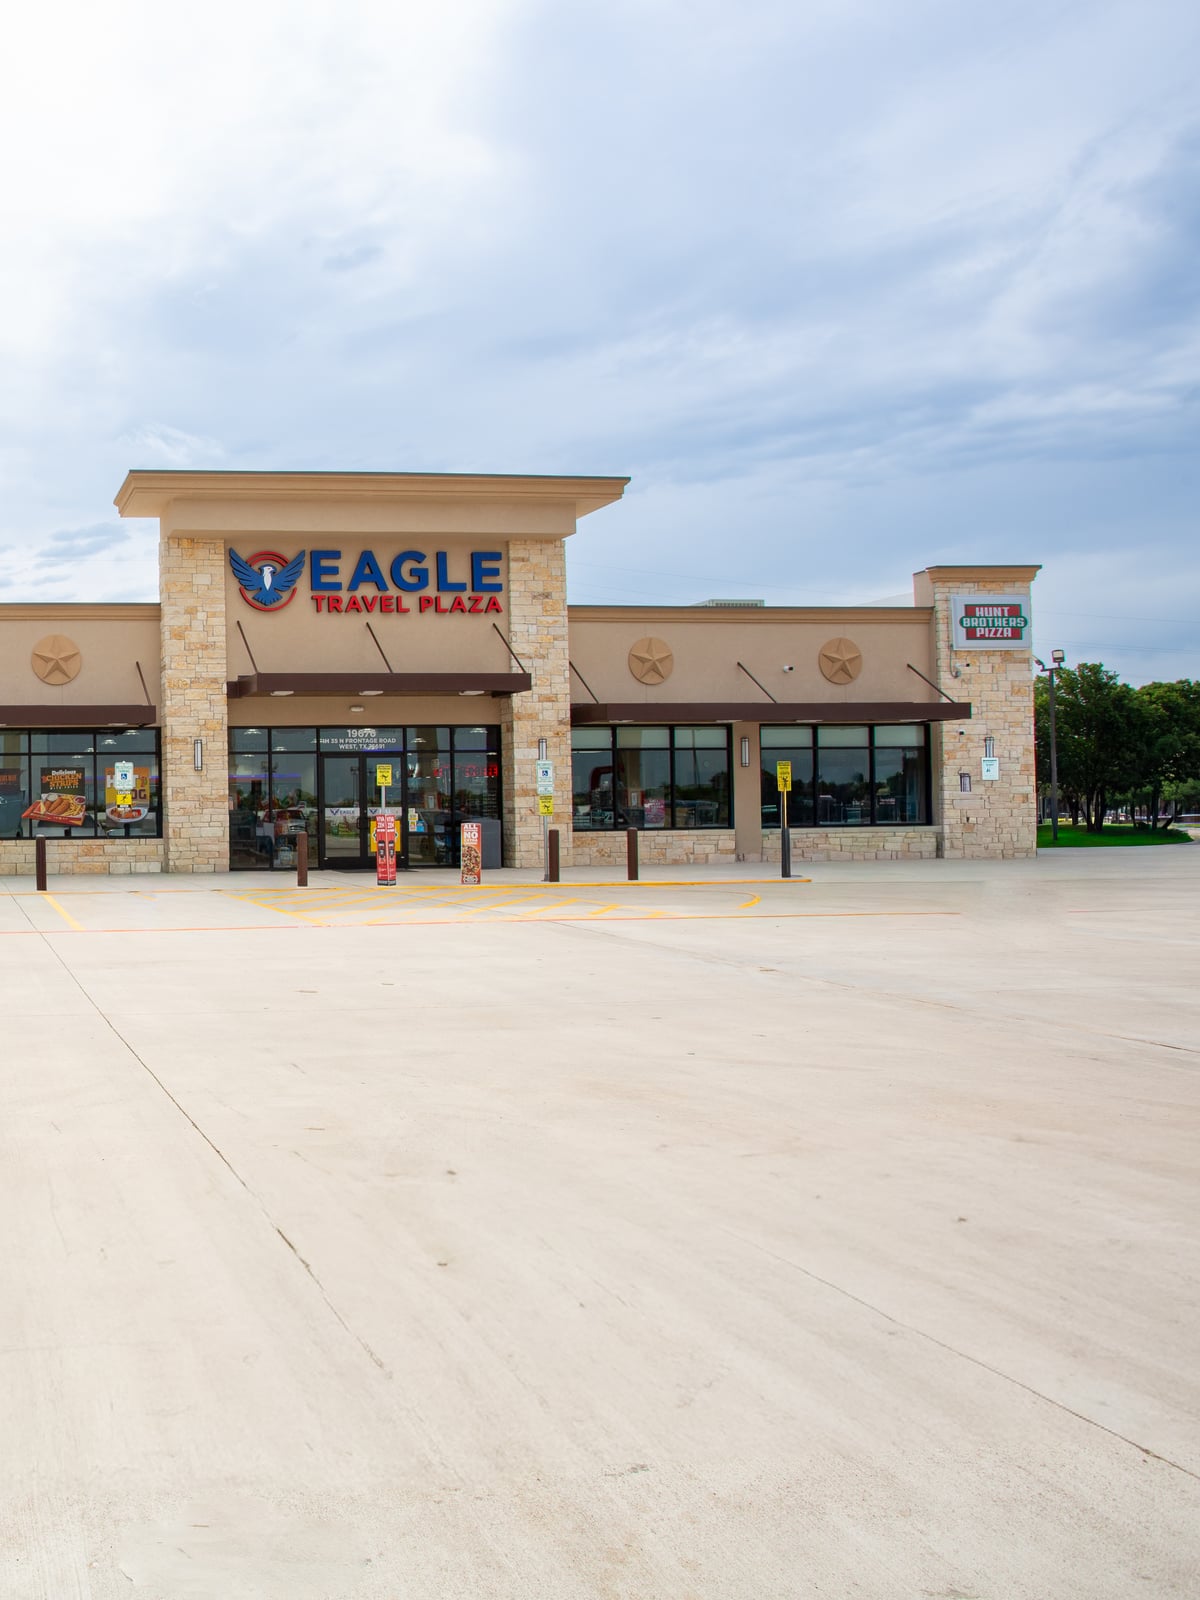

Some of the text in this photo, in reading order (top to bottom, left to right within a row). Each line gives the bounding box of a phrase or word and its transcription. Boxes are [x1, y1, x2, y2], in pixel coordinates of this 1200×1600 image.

[310, 550, 503, 592] EAGLE
[311, 595, 503, 613] TRAVEL PLAZA
[975, 606, 1009, 616] HUNT
[963, 617, 1025, 627] BROTHERS
[975, 628, 1012, 637] PIZZA
[46, 773, 82, 781] CHICKEN
[49, 780, 79, 788] STRIPS
